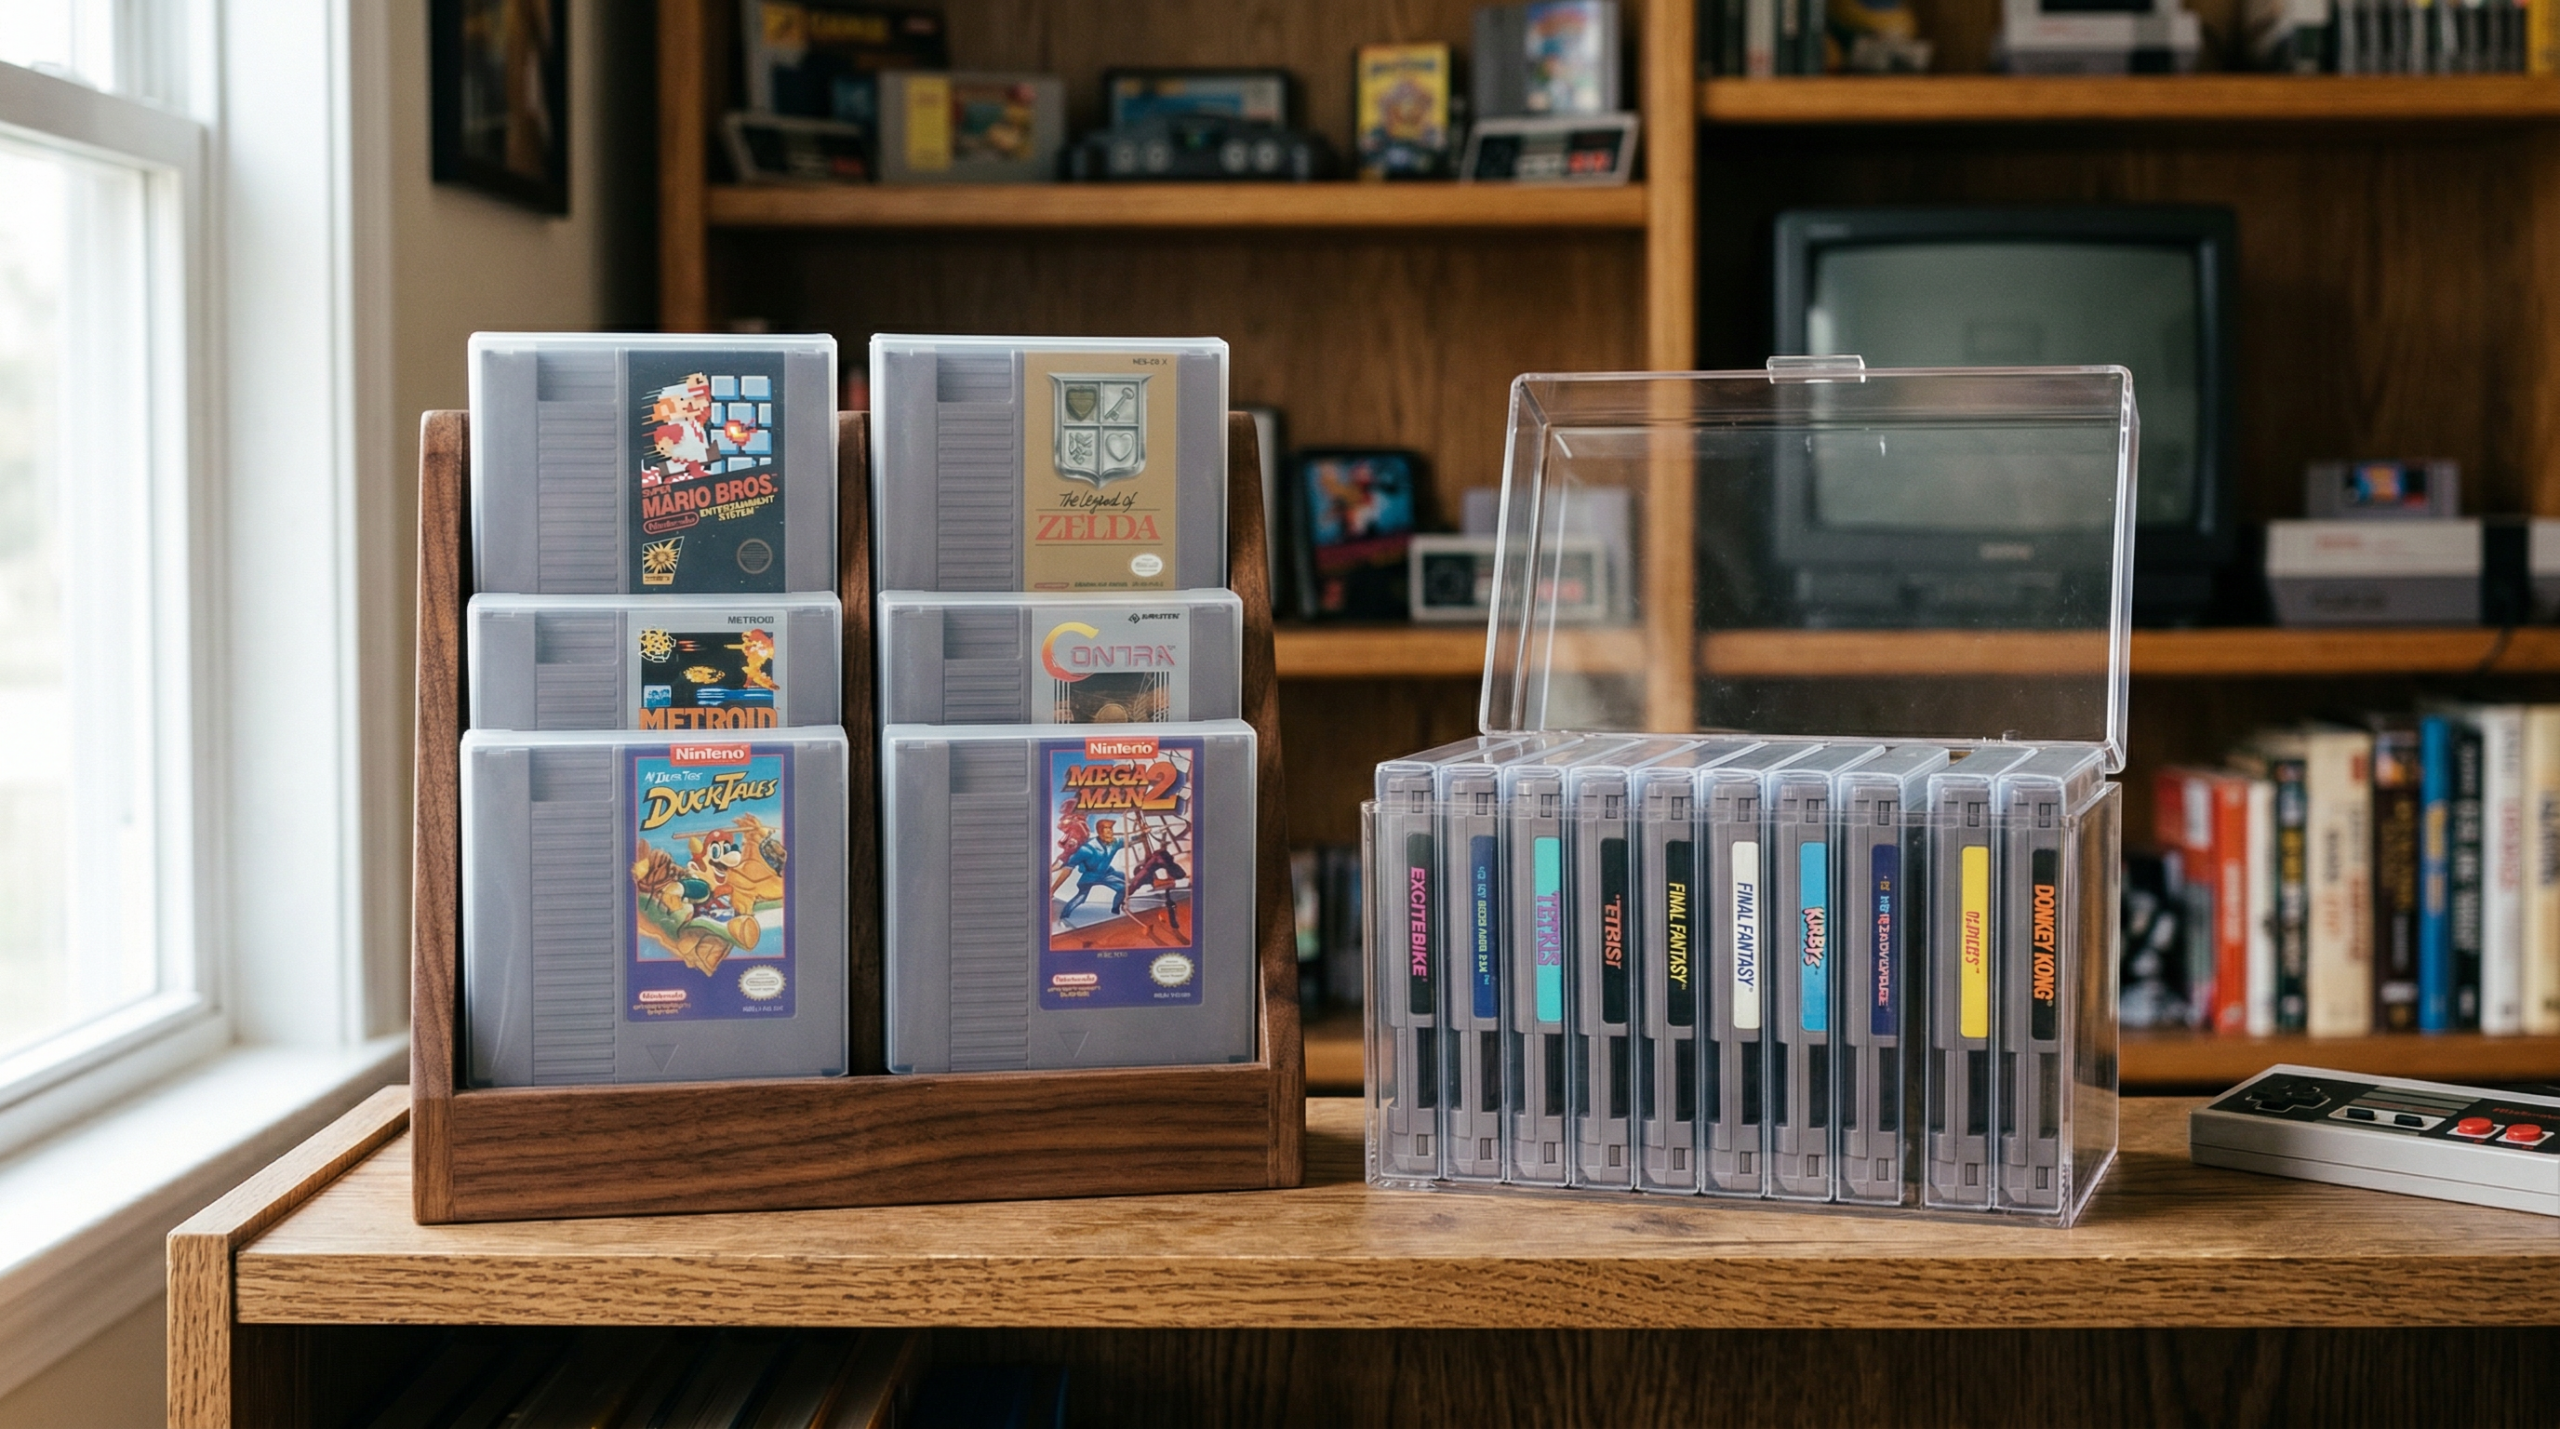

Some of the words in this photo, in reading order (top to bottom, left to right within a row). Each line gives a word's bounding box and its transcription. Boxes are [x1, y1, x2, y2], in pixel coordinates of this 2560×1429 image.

[642, 486, 711, 520] MARIO
[1059, 490, 1079, 507] The
[1122, 491, 1138, 513] of
[1034, 514, 1161, 541] ZELDA
[639, 706, 779, 729] METROID
[1065, 763, 1150, 788] MEGA
[1076, 787, 1147, 810] MAN
[1141, 761, 1179, 811] 2
[1410, 866, 1428, 977] EXCITEBIKE
[1669, 882, 1687, 920] FINAL
[1736, 882, 1754, 921] FINAL
[2034, 884, 2055, 951] DONKEY
[1536, 890, 1561, 966] TETRIS
[1669, 923, 1688, 984] FANTASY
[1737, 923, 1755, 988] FANTASY
[2034, 952, 2055, 1002] KONG
